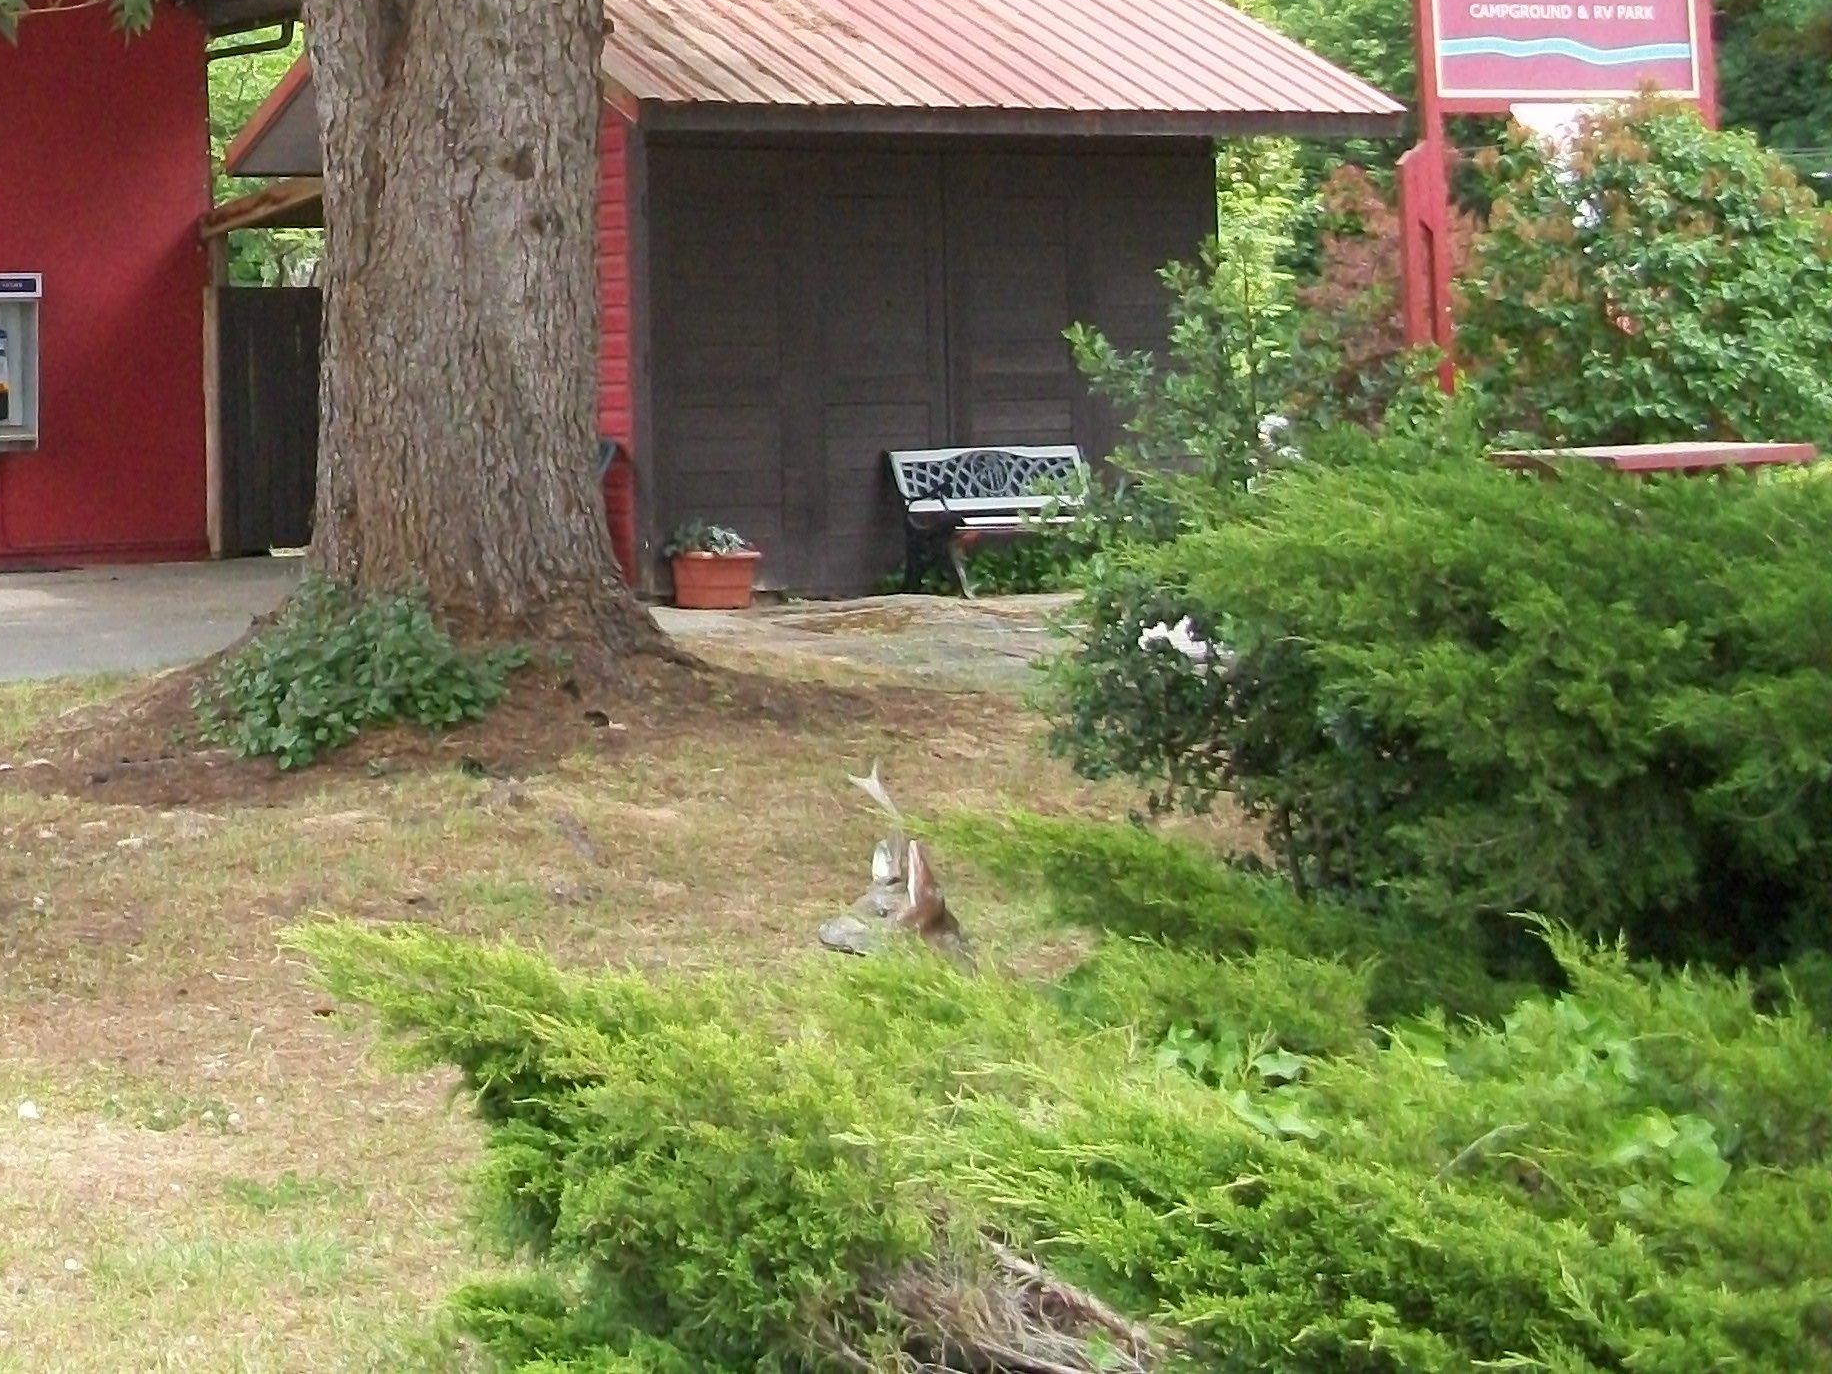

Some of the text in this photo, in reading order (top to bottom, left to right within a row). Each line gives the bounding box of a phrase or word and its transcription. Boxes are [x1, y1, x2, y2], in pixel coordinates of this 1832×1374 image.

[1469, 3, 1655, 21] CAMPGROUND & RV PARK
